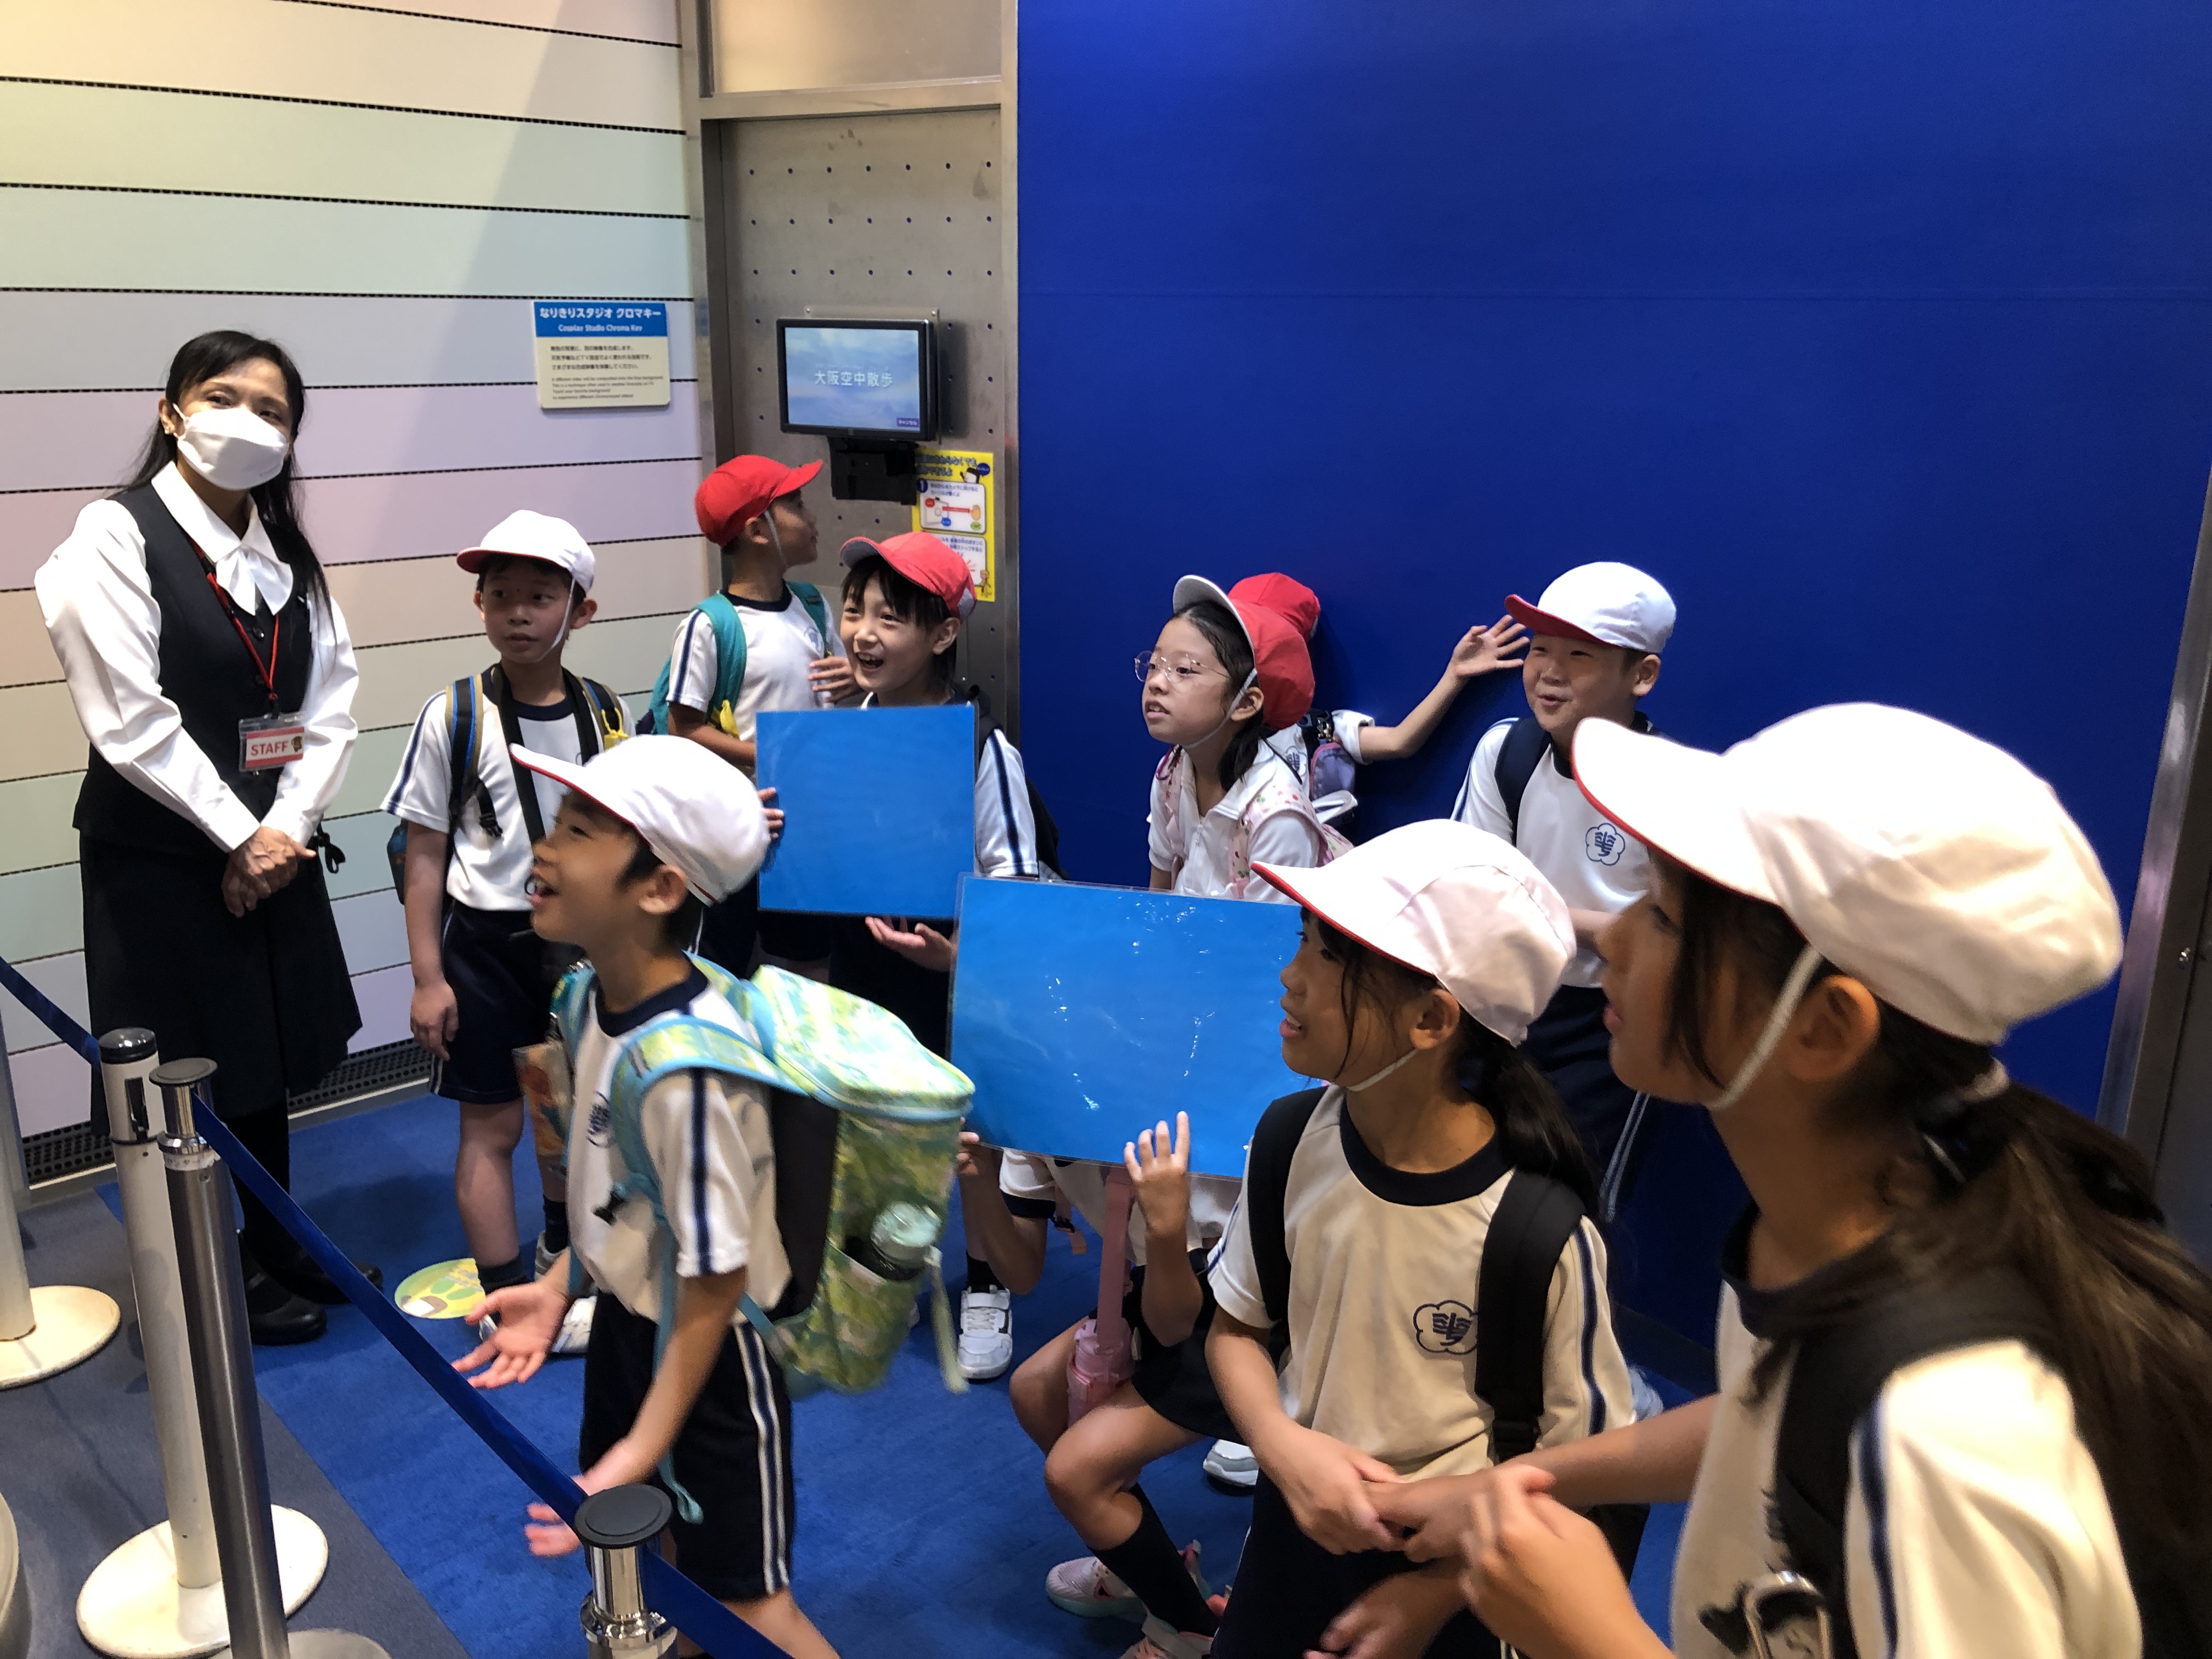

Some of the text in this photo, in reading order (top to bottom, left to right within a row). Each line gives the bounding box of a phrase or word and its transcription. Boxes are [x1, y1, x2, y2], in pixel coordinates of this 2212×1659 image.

[539, 307, 661, 319] なりきりスタジオ クロマキー
[815, 370, 894, 387] 大阪空中散歩
[251, 740, 289, 757] STAFF
